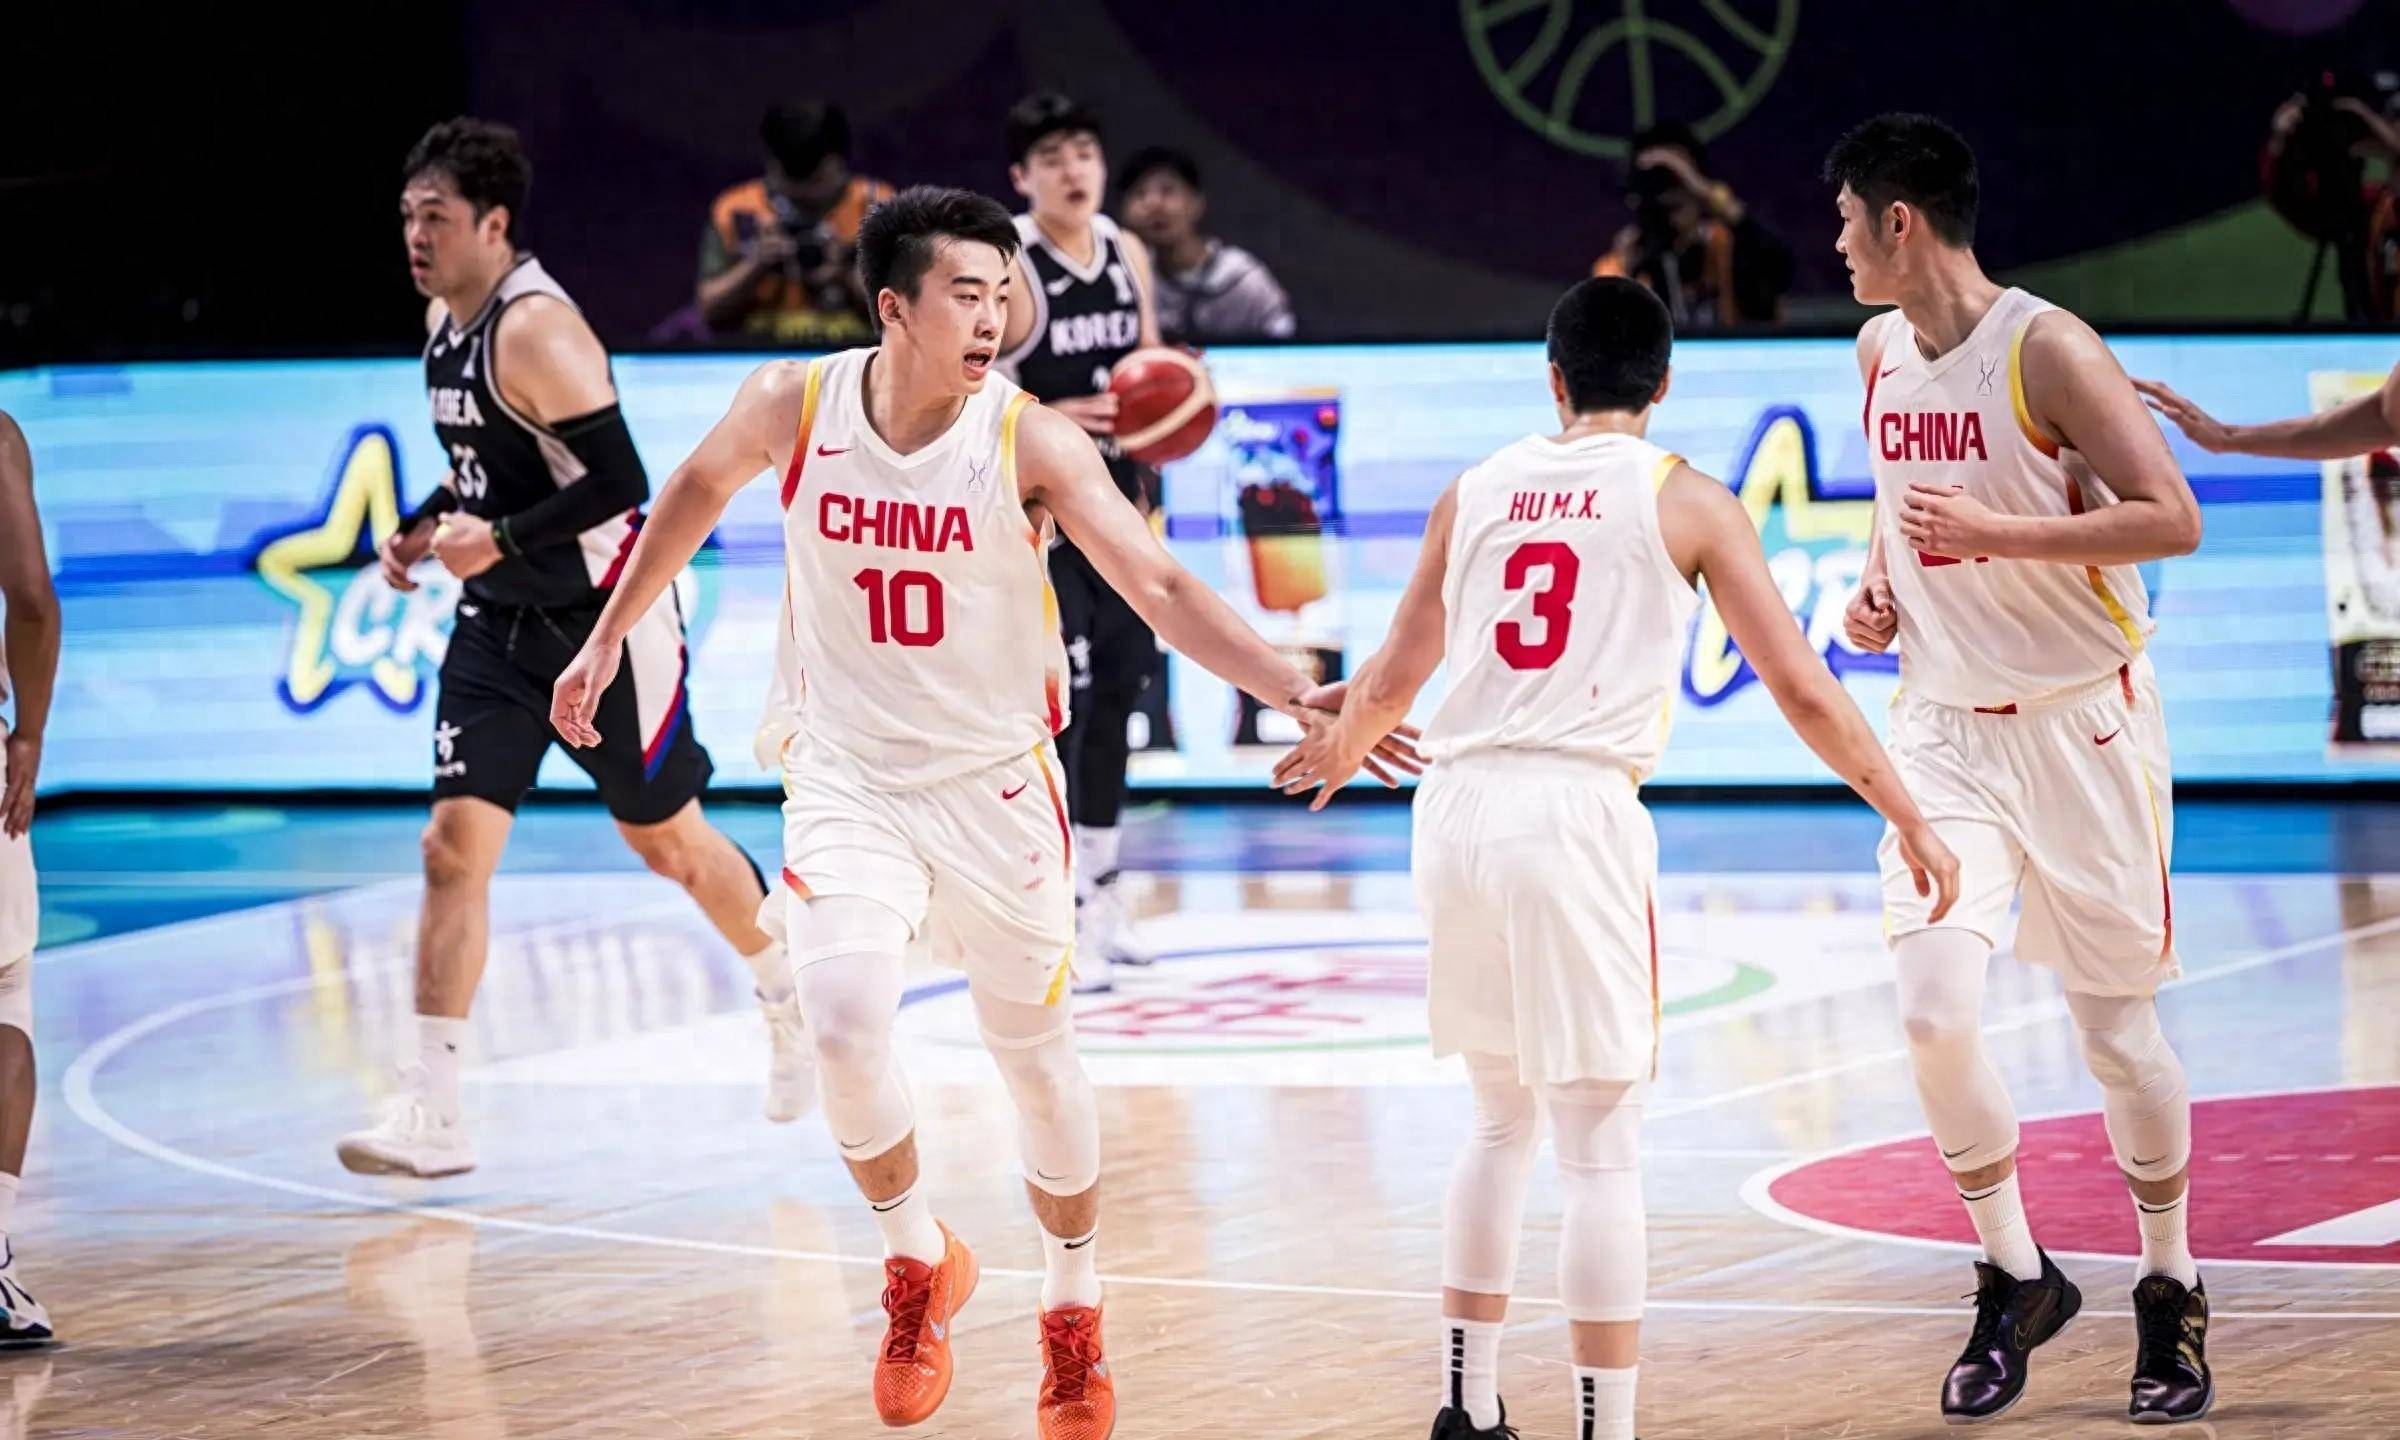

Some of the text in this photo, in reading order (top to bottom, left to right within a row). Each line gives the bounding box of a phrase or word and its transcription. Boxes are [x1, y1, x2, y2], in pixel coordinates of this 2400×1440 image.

[1880, 412, 1988, 461] CHINA
[819, 492, 974, 552] CHINA
[1508, 489, 1602, 521] HU M.X.
[853, 568, 944, 646] 10
[1495, 542, 1580, 670] 3
